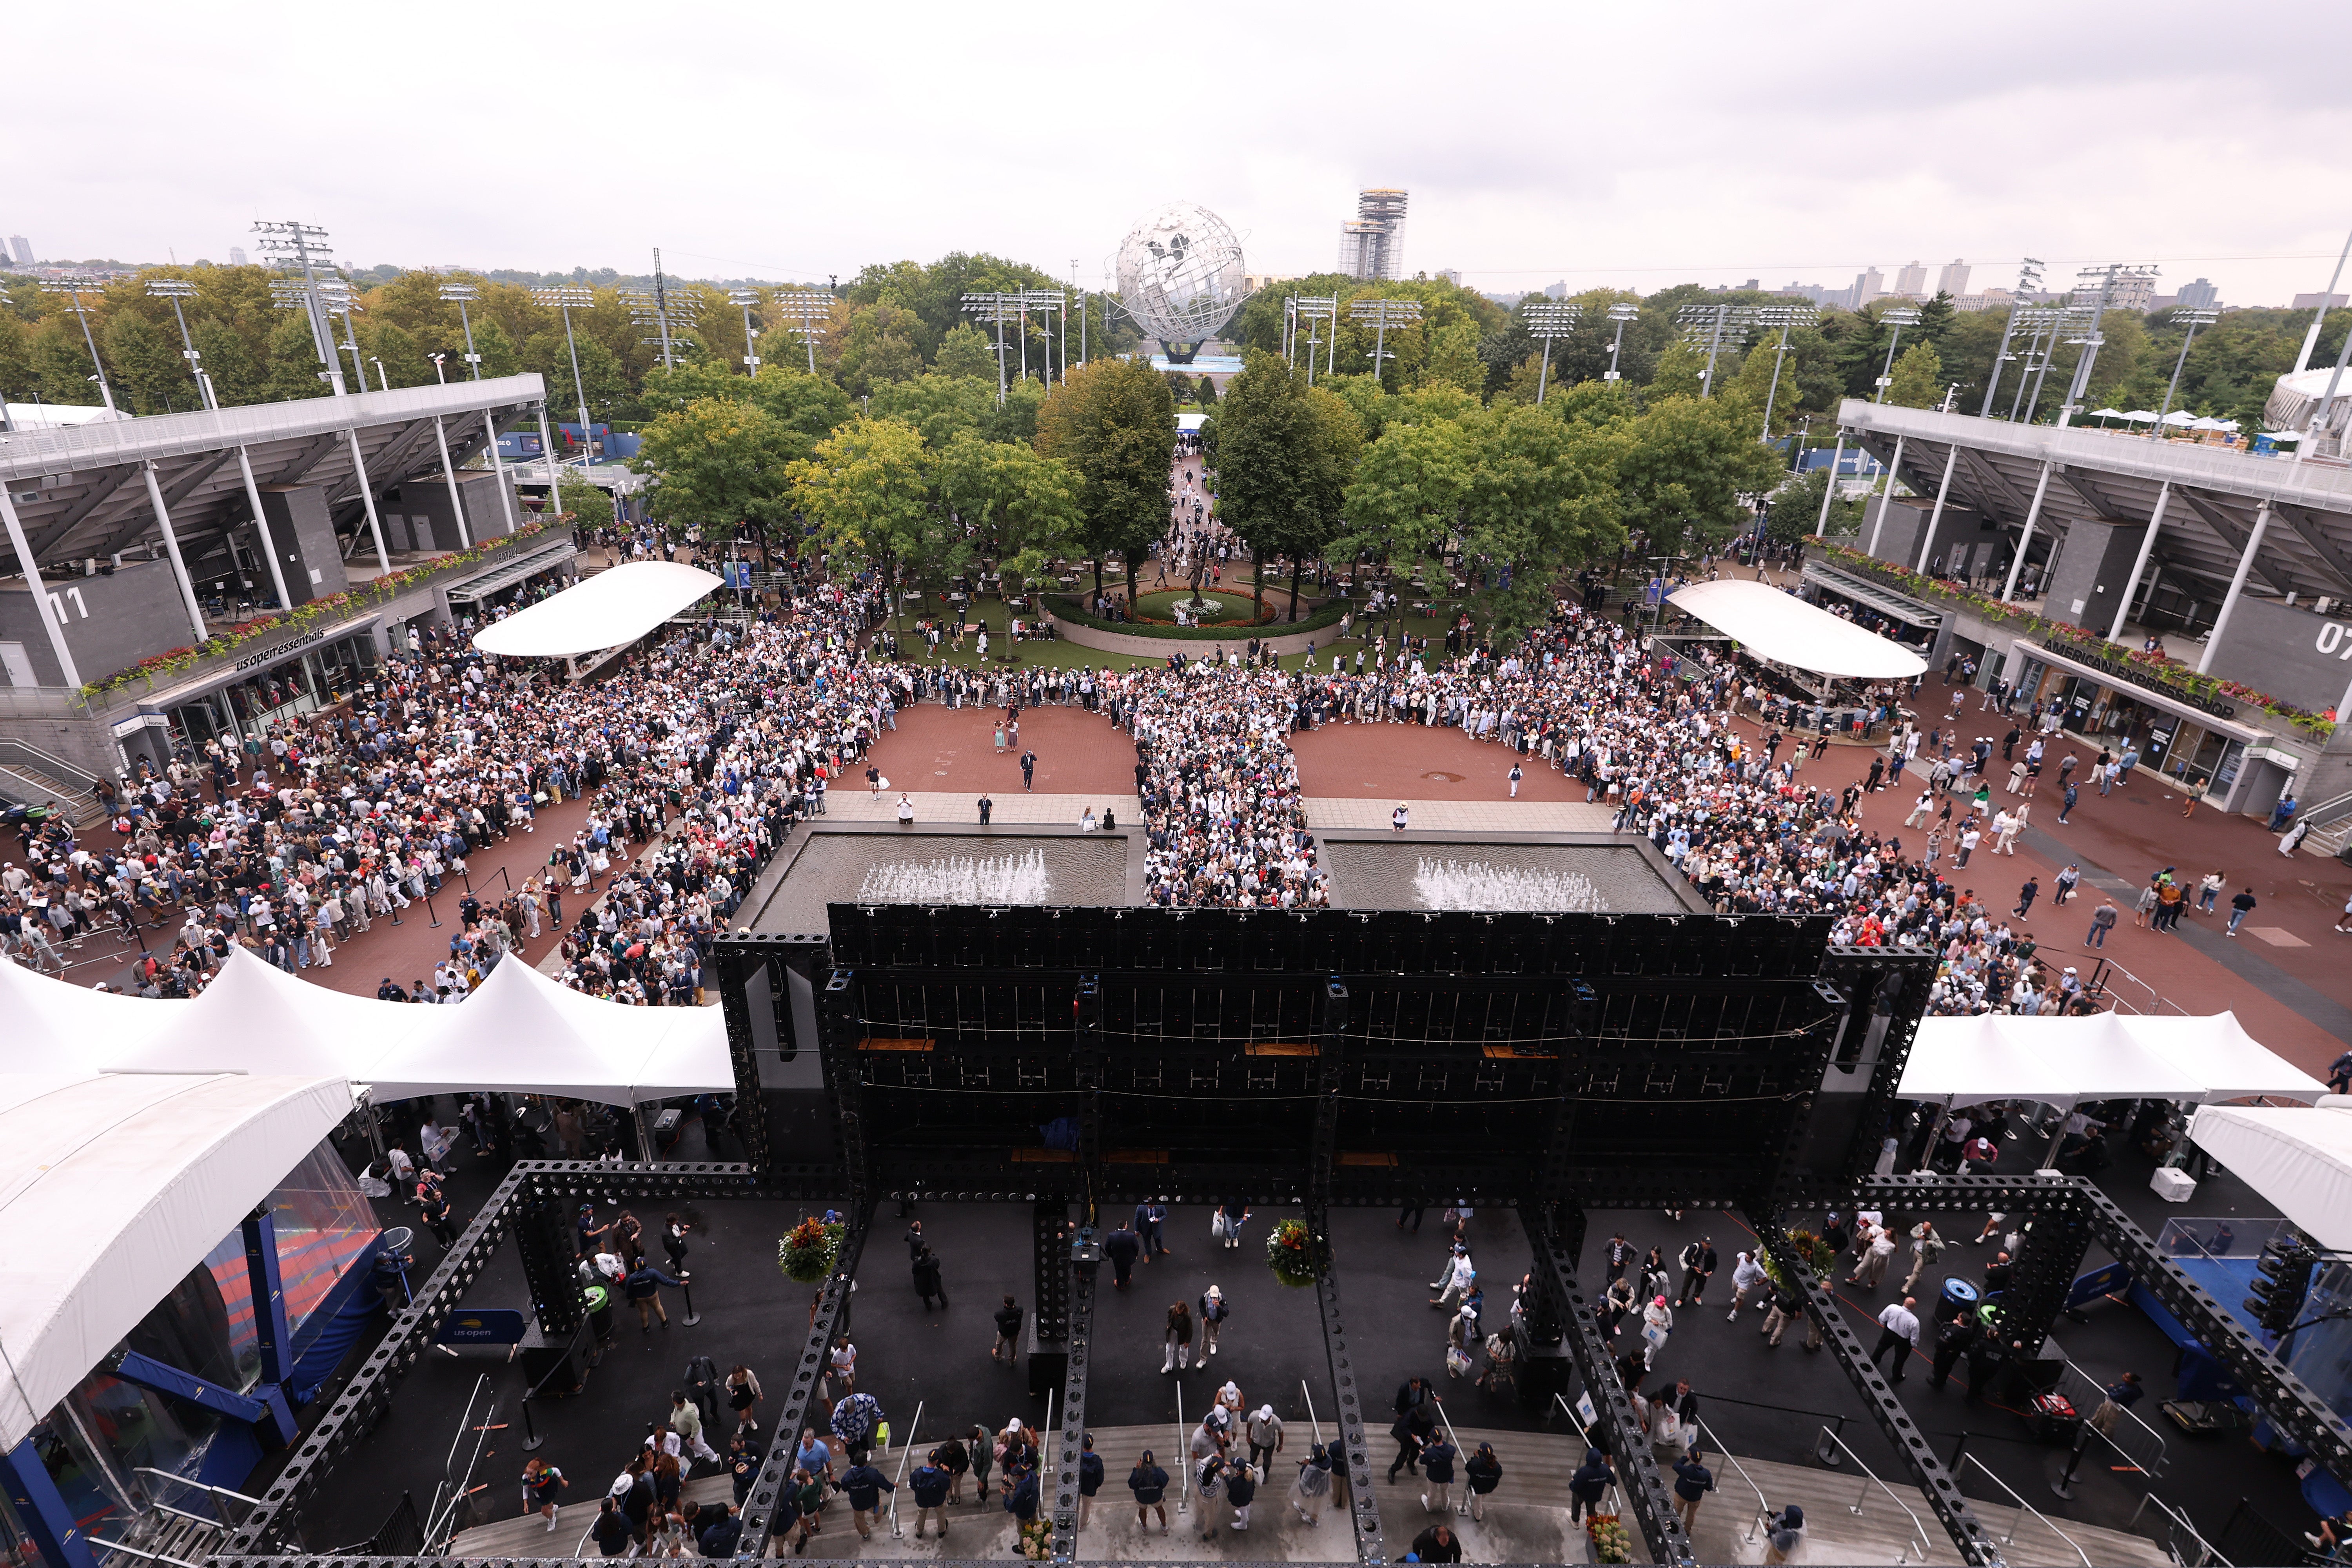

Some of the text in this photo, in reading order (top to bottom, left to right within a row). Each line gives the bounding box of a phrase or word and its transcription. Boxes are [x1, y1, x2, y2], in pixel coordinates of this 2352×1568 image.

[497, 547, 517, 563] EATALY
[47, 587, 89, 624] 11
[236, 627, 324, 671] us open essentials
[2316, 622, 2352, 661] 07
[2045, 639, 2235, 719] AMERICAN EXPRESS SHOP
[120, 726, 135, 735] Women
[117, 744, 131, 770] WOMEN
[2278, 775, 2294, 801] WOMEN
